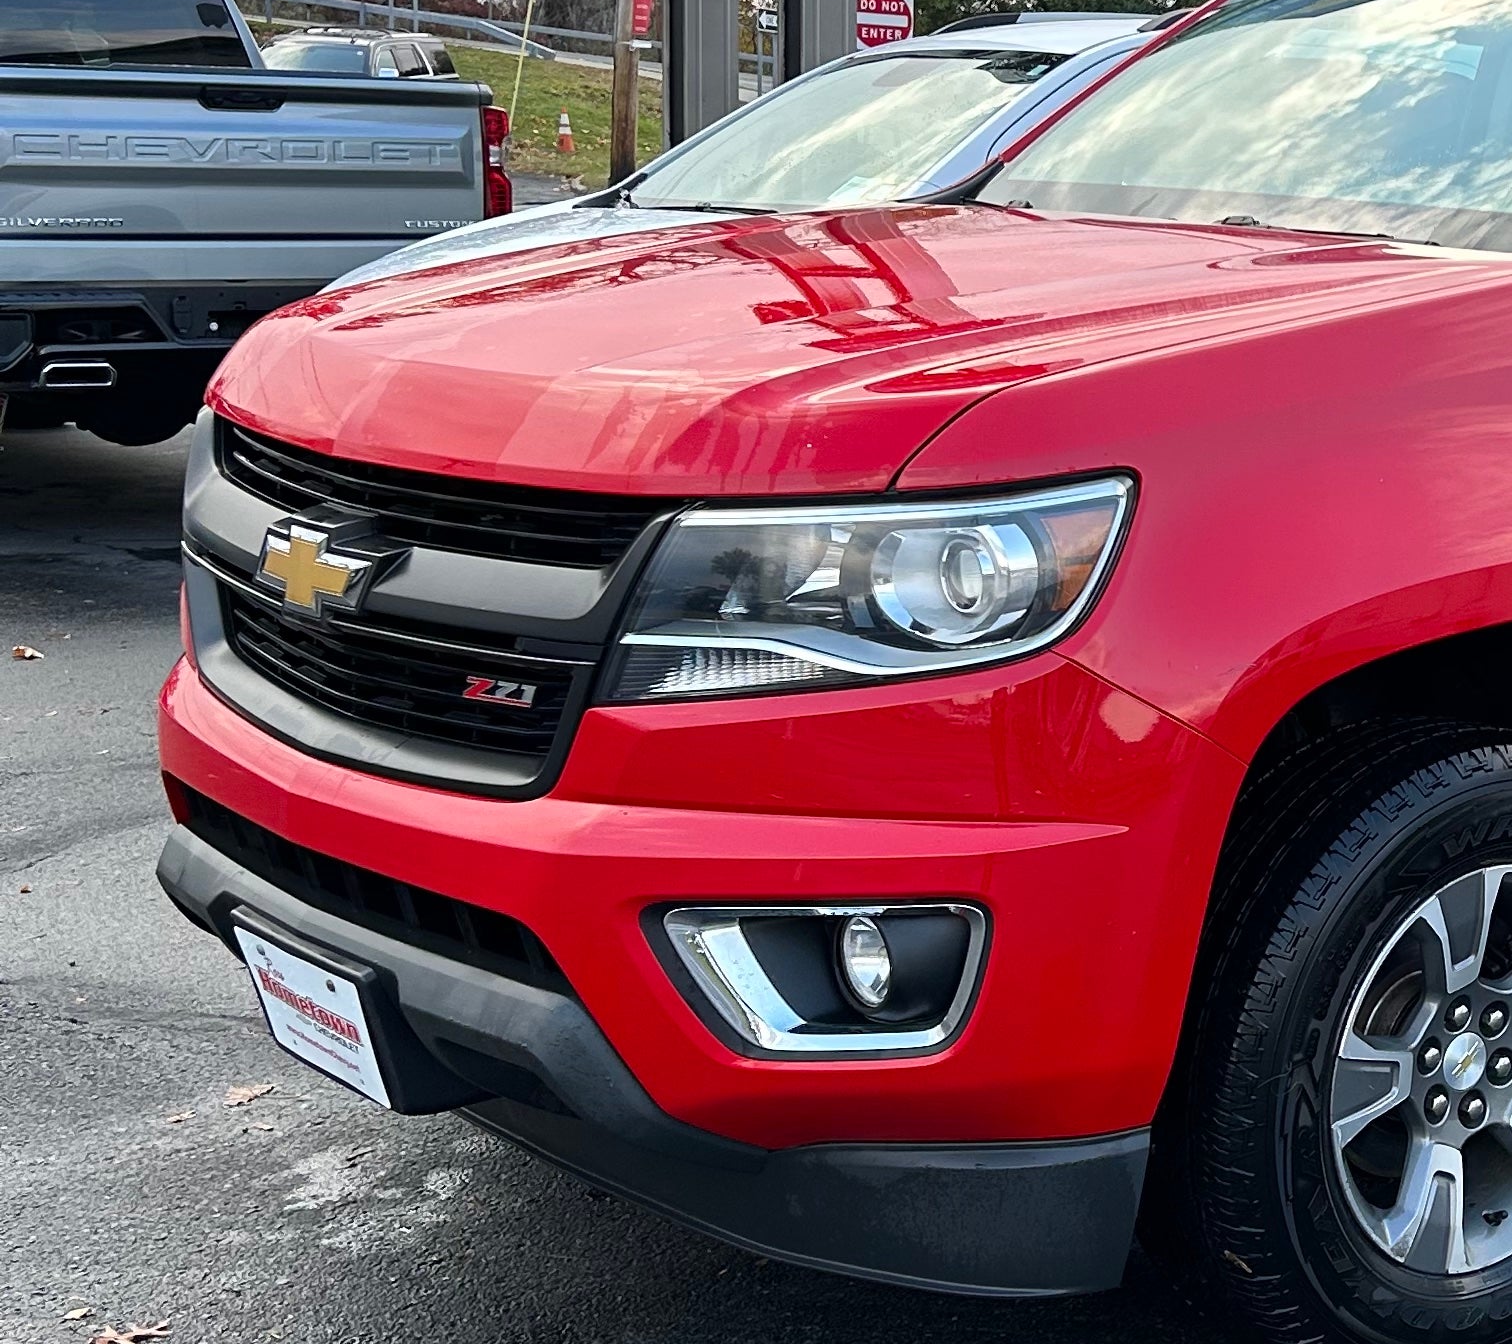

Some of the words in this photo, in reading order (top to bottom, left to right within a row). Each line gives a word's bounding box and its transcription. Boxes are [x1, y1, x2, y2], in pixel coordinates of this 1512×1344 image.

[881, 0, 905, 13] NOT
[861, 26, 902, 41] ENTER
[13, 133, 457, 166] CHEVROLET
[462, 675, 538, 708] Z71
[256, 966, 363, 1046] Hometown
